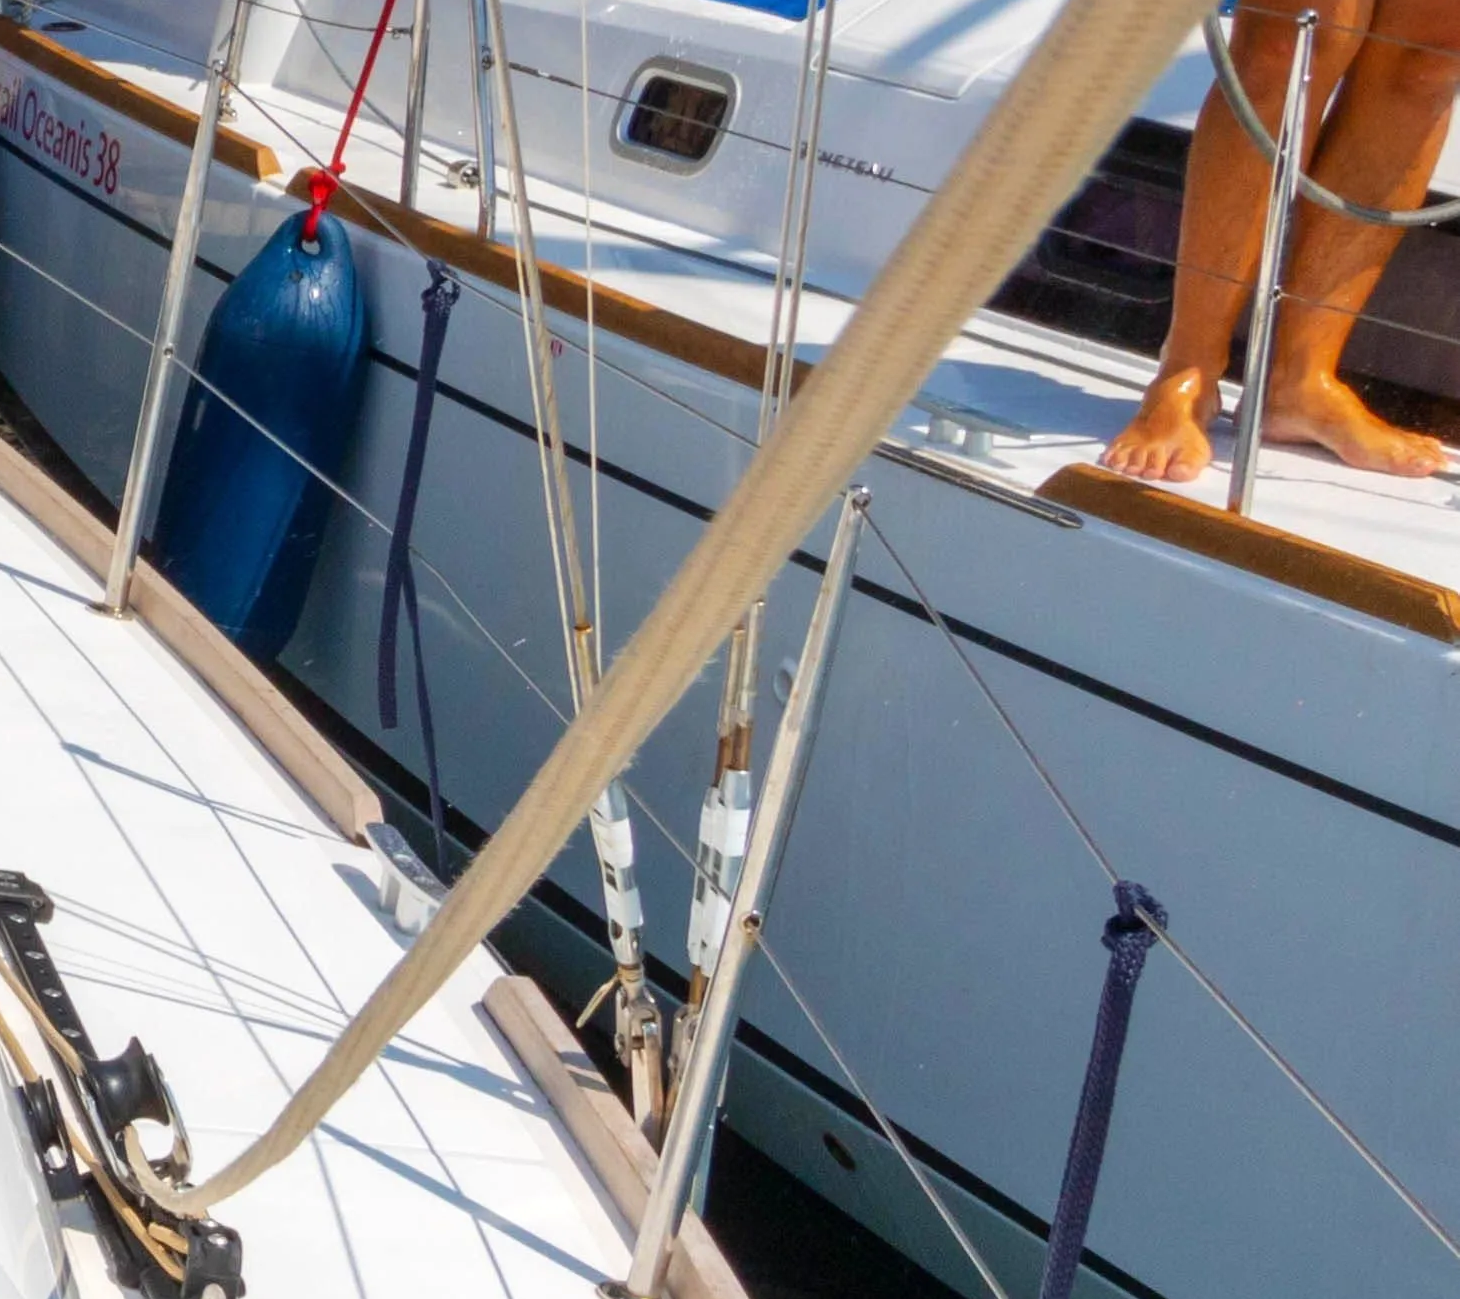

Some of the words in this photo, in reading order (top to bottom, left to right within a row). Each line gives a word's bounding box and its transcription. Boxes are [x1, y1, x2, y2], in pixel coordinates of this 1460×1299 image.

[22, 89, 93, 179] Oceanis
[93, 131, 121, 195] 38
[799, 140, 895, 182] BNETEAU
